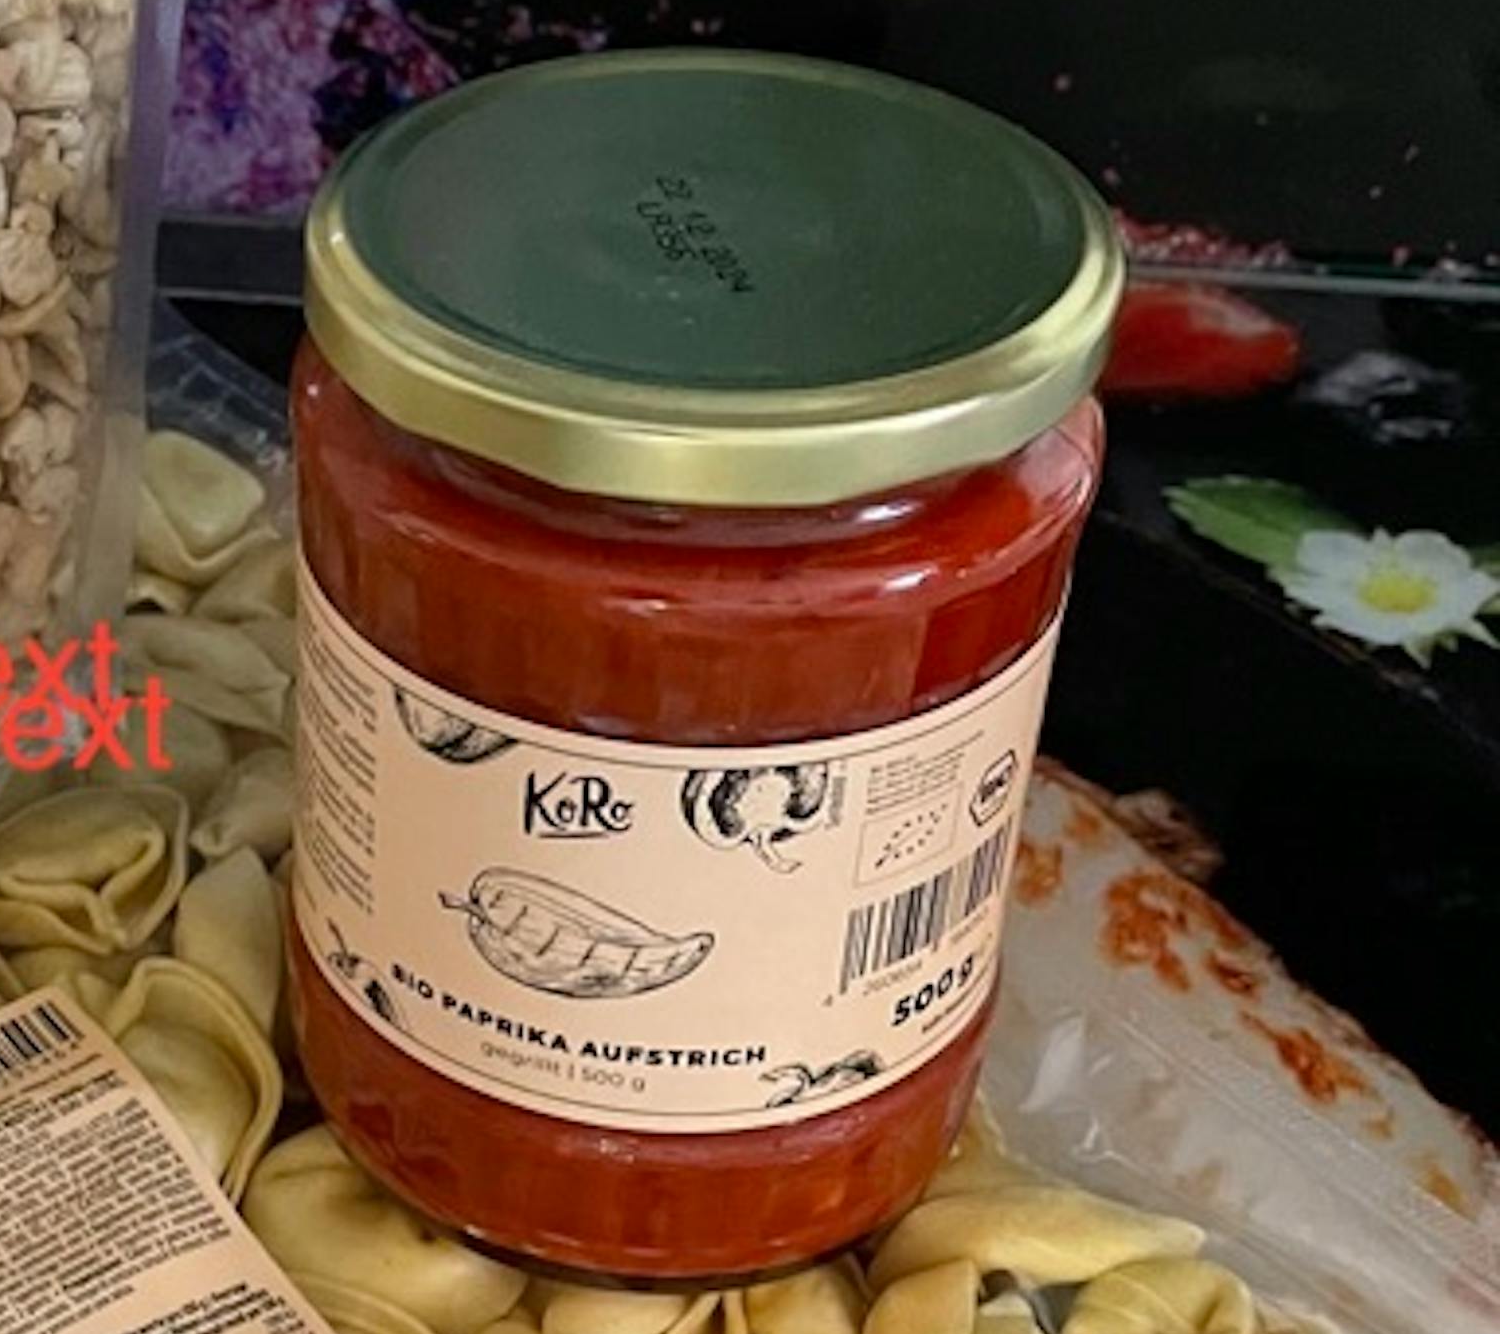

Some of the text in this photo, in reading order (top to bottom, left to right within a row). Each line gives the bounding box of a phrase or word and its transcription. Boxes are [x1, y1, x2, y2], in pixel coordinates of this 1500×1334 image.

[523, 770, 634, 839] KoRo
[391, 964, 767, 1068] BIO PAPRIKA AUFSTRICH
[890, 967, 955, 1029] 500
[955, 953, 974, 989] g
[580, 1067, 626, 1090] 500
[631, 1075, 647, 1094] g
